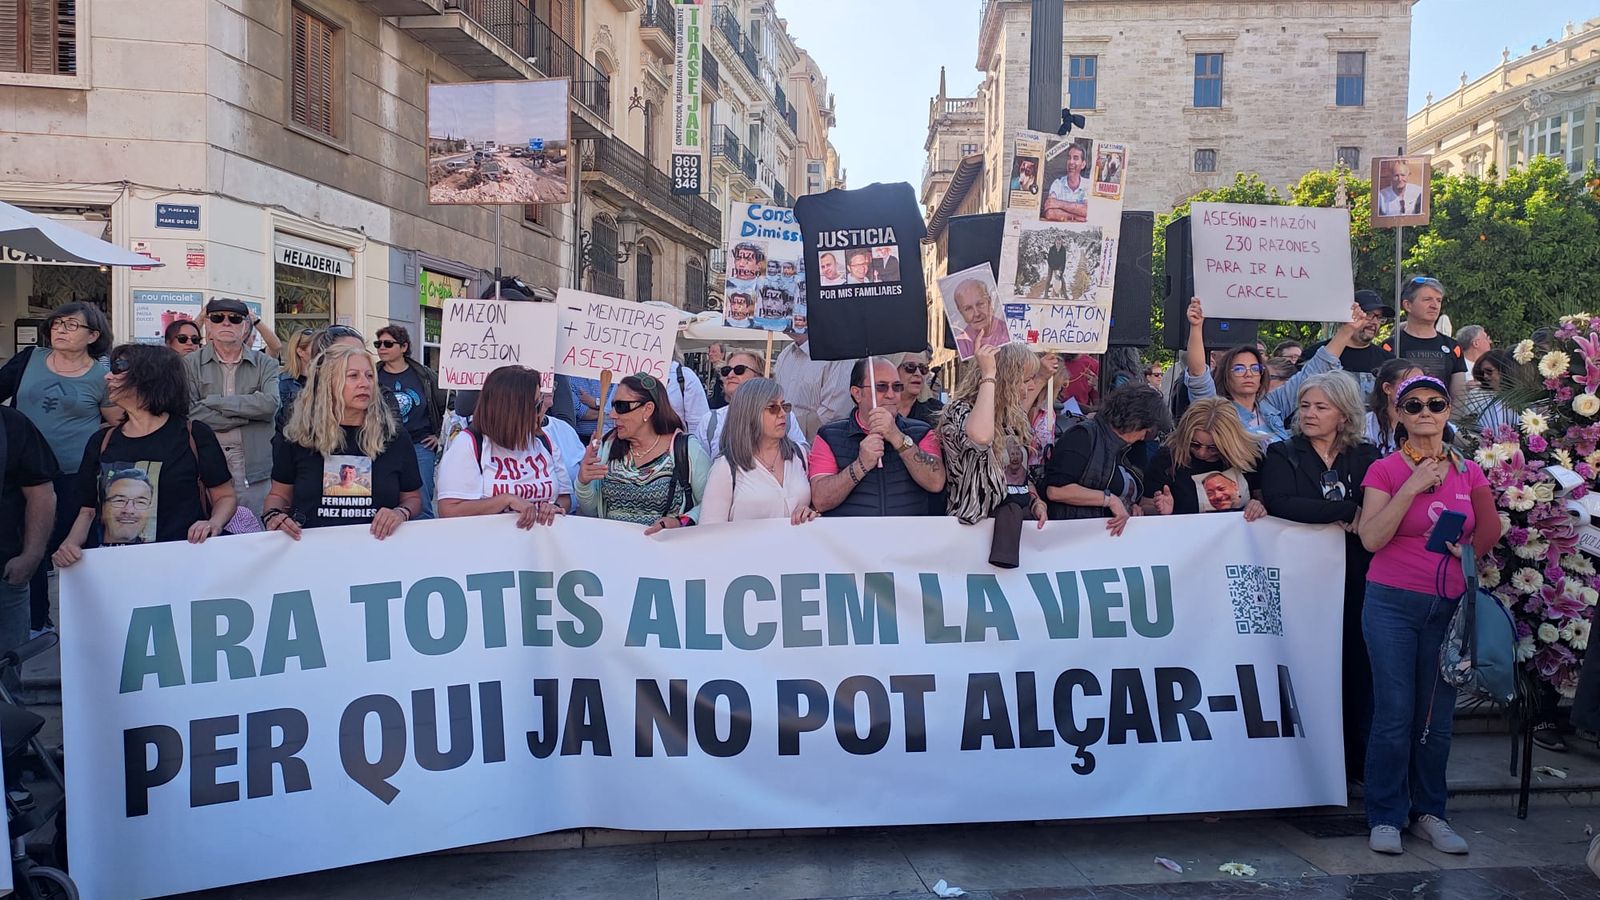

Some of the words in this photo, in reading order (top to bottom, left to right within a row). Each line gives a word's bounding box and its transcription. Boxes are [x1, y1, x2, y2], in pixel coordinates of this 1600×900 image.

[686, 8, 700, 146] TRASEJAR
[675, 156, 698, 167] 960
[675, 167, 698, 178] 032
[675, 178, 698, 189] 346
[816, 226, 897, 249] JUSTICIA
[1225, 234, 1252, 252] 230
[1259, 237, 1321, 254] RAZONES
[283, 249, 342, 275] HELADERIA
[1206, 258, 1242, 274] PARA
[1250, 262, 1267, 275] IR
[1275, 264, 1286, 277] A
[1290, 266, 1310, 279] LA
[160, 293, 194, 302] micalet
[820, 289, 836, 300] POR
[838, 288, 853, 298] MIS
[854, 285, 903, 297] FAMILIARES
[1226, 283, 1289, 299] CARCEL
[449, 303, 508, 325] MAZON
[588, 302, 666, 331] MENTIRAS
[1066, 320, 1080, 328] AL
[481, 326, 497, 343] A
[583, 321, 663, 354] JUSTICIA
[450, 343, 521, 363] PRISION
[562, 345, 667, 380] ASESINOS
[514, 481, 553, 499] OBLIT
[321, 497, 373, 507] FERNANDO
[318, 508, 340, 518] PAEZ
[341, 508, 378, 518] ROBLES
[118, 588, 327, 694] ARA
[350, 569, 604, 663] TOTES
[624, 571, 900, 651] ALCEM
[919, 572, 1021, 645] LA
[1026, 565, 1175, 640] VEU
[123, 707, 313, 818] PER
[338, 680, 506, 806] QUI
[526, 678, 613, 759] JA
[635, 678, 753, 758] NO
[777, 673, 937, 758] POT
[960, 664, 1306, 776] ALÇAR-LA
